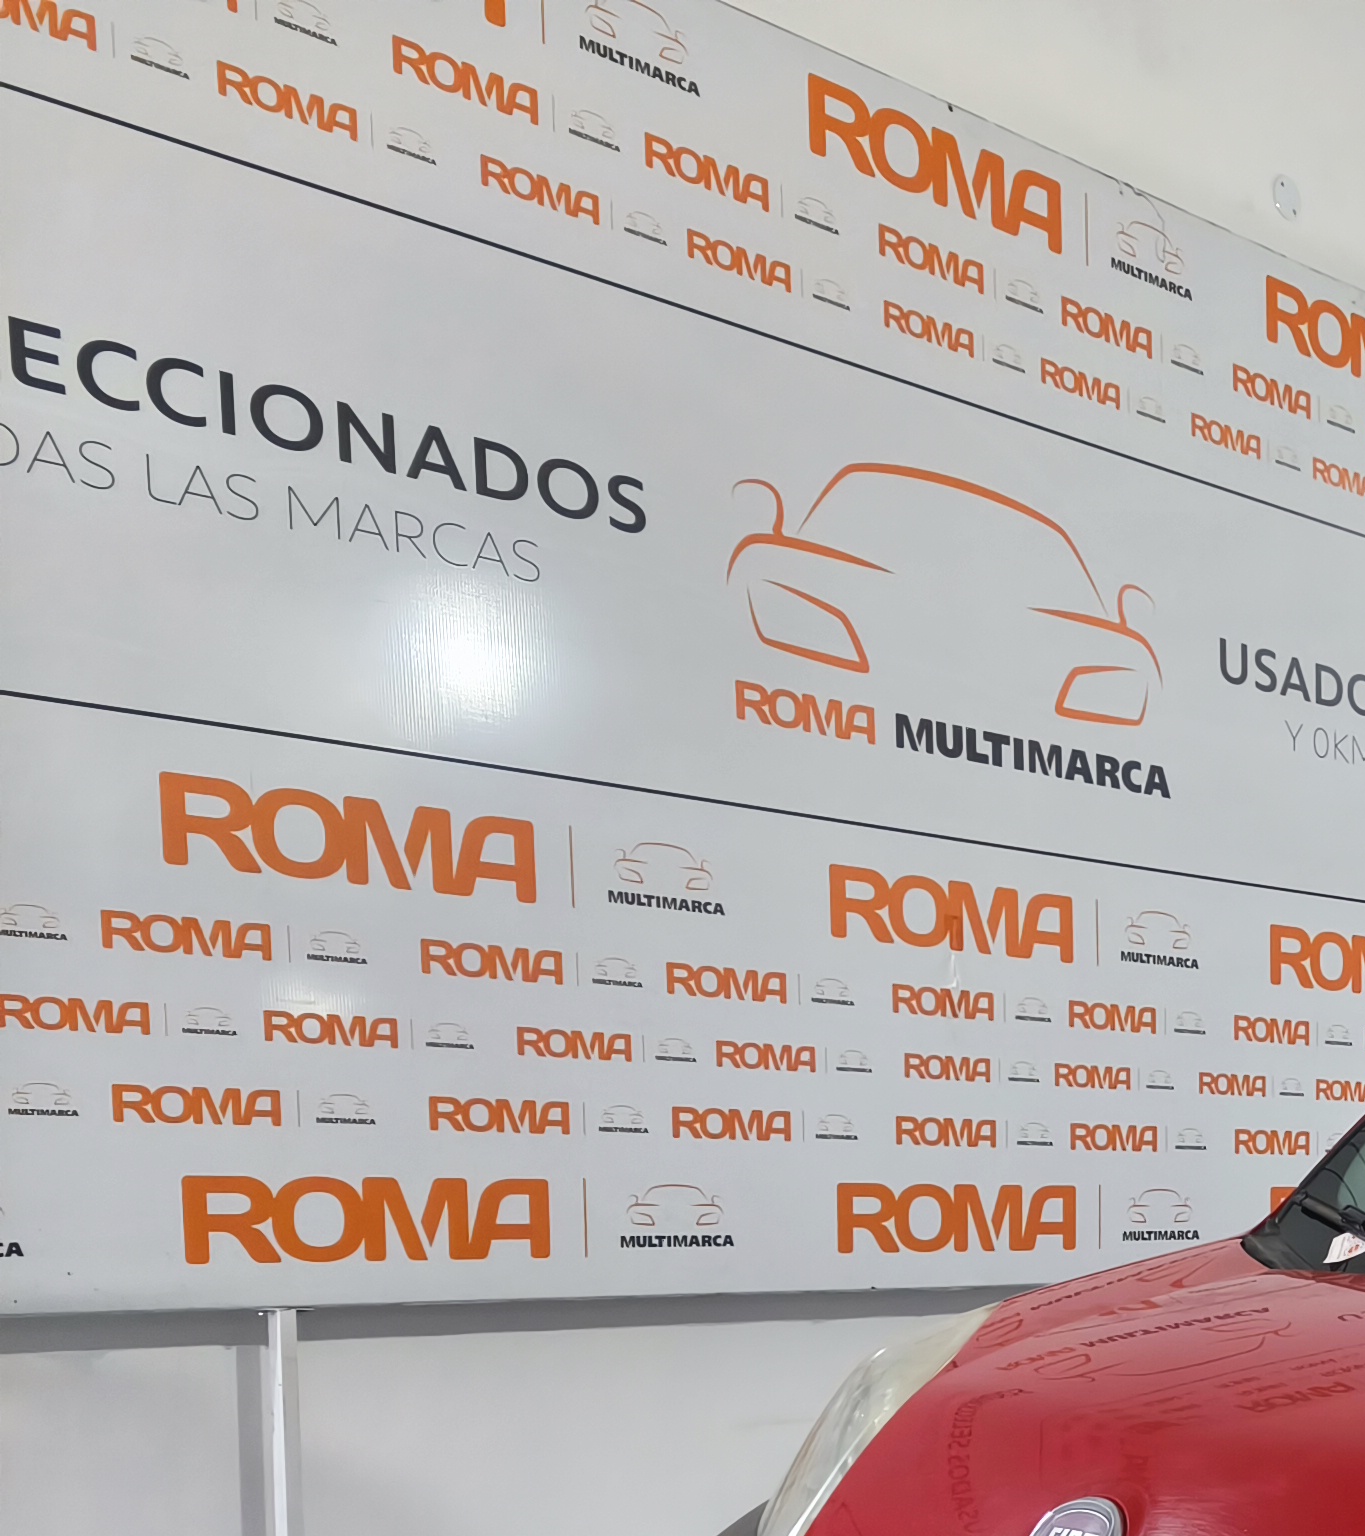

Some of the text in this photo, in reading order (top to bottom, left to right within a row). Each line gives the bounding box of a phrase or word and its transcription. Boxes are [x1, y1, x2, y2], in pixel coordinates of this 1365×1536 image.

[0, 0, 97, 52] MA
[392, 36, 539, 126] ROMA
[578, 34, 701, 98] MULTIMARCA
[216, 60, 358, 143] ROMA
[645, 132, 770, 213] ROMA
[808, 74, 1062, 256] ROMA
[481, 154, 600, 226] ROMA
[688, 228, 792, 293] ROMA
[879, 223, 984, 295] ROMA
[1110, 256, 1193, 302] MULTIMARCA
[883, 300, 974, 359] ROMA
[1061, 296, 1152, 359] ROMA
[1041, 358, 1120, 411] ROMA
[1233, 364, 1311, 420] ROMA
[1191, 413, 1261, 460] ROMA
[145, 453, 259, 522] LAS
[287, 485, 541, 584] MARCAS
[736, 681, 1171, 800] ROMA MULTIMARCA
[1283, 719, 1304, 753] Y
[160, 771, 537, 904] ROMA
[607, 889, 726, 916] MULTIMARCA
[829, 864, 1074, 964] ROMA
[101, 910, 272, 962] ROMA
[421, 939, 564, 985] ROMA
[1120, 950, 1200, 970] MULTIMARCA
[666, 962, 787, 1005] ROMA
[892, 984, 994, 1021] ROMA
[0, 993, 150, 1036] ROMA
[263, 1010, 398, 1049] ROMA
[1068, 1001, 1156, 1036] ROMA
[1233, 1015, 1310, 1046] ROMA
[517, 1027, 632, 1063] ROMA
[716, 1041, 816, 1073] ROMA
[904, 1054, 990, 1084] ROMA
[1055, 1063, 1131, 1091] ROMA
[1199, 1072, 1266, 1098] ROMA
[112, 1084, 282, 1127] ROMA
[430, 1096, 570, 1136] ROMA
[672, 1107, 792, 1142] ROMA
[896, 1117, 996, 1149] ROMA
[1070, 1124, 1158, 1153] ROMA
[1235, 1130, 1310, 1157] ROMA
[182, 1176, 551, 1266] ROMA
[620, 1234, 735, 1249] MULTIMARCA
[836, 1183, 1076, 1256] ROMA
[1122, 1229, 1200, 1242] MULTIMARCA
